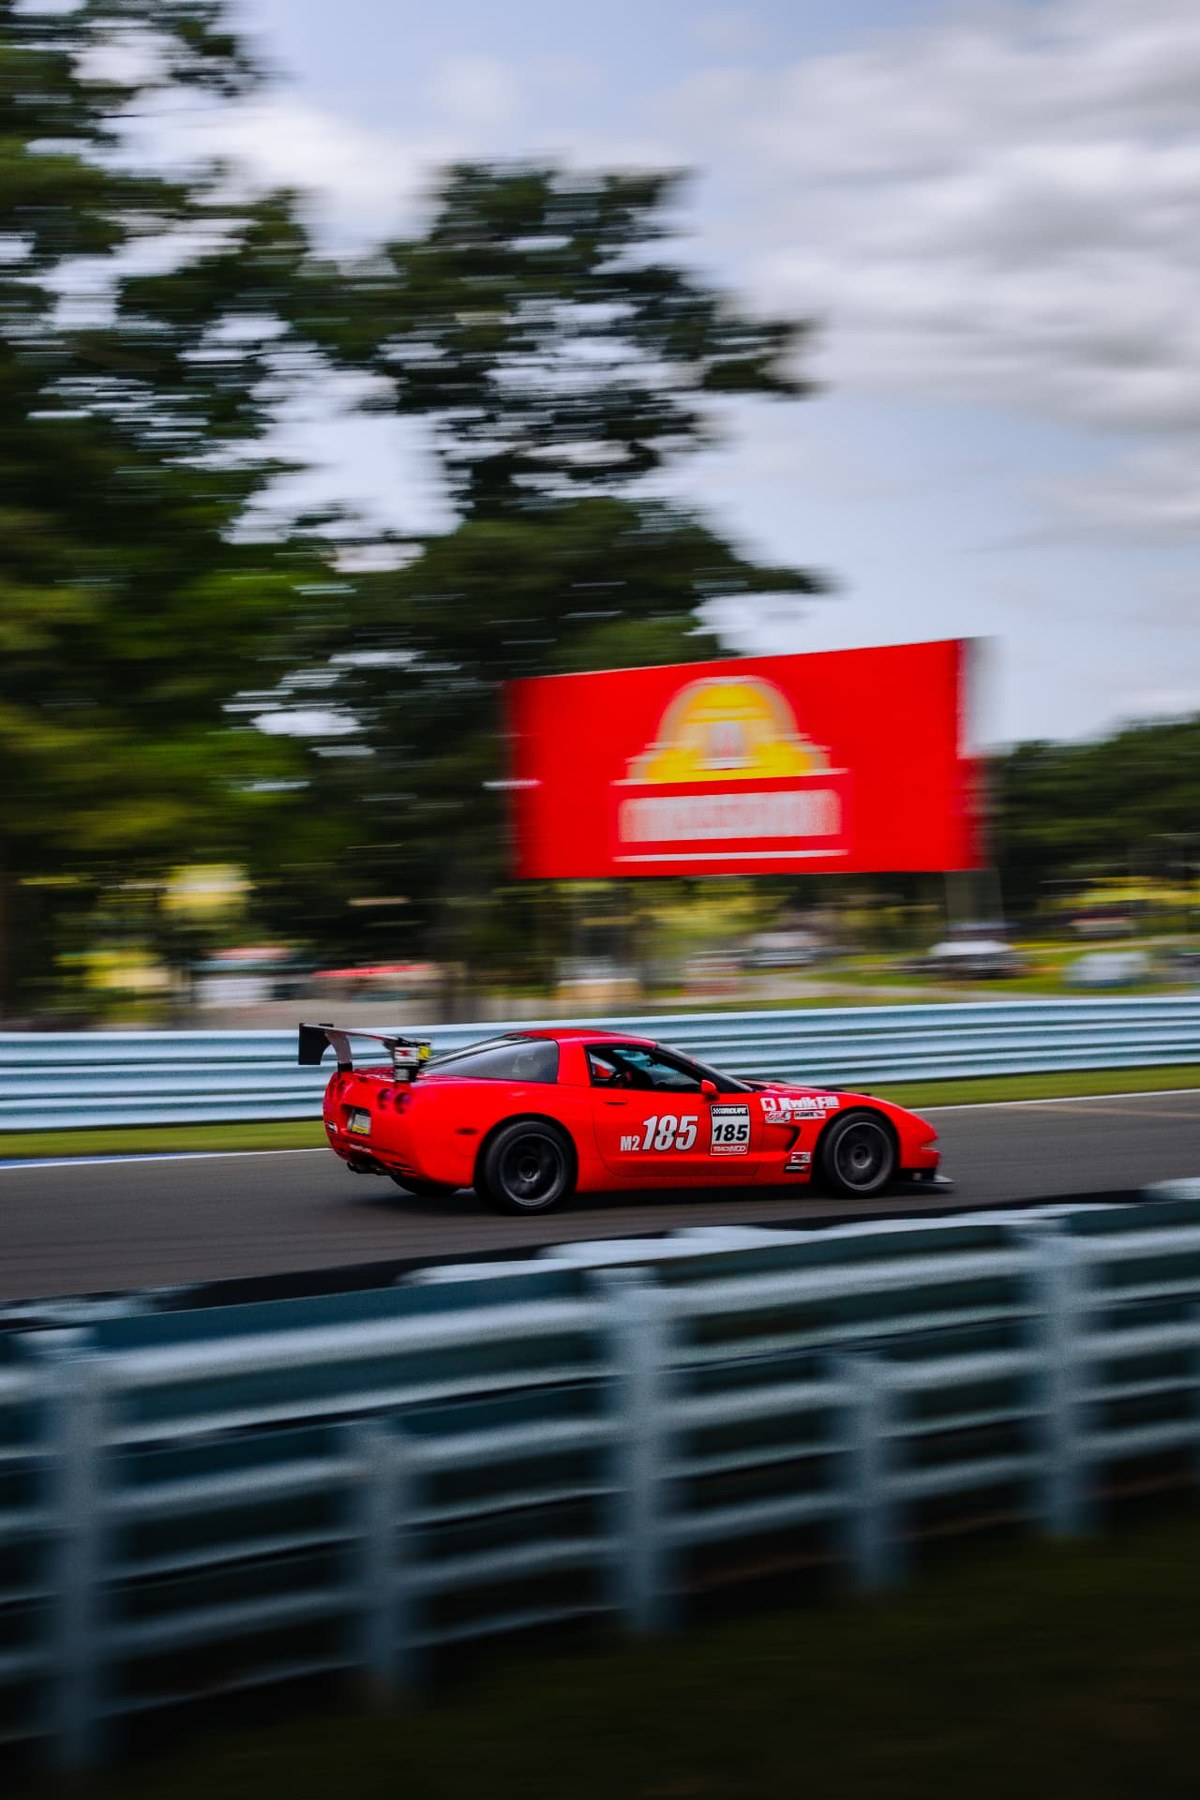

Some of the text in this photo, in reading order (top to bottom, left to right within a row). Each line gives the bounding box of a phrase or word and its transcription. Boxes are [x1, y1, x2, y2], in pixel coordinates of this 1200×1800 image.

[620, 1115, 699, 1151] M2 185
[713, 1124, 748, 1142] 185
